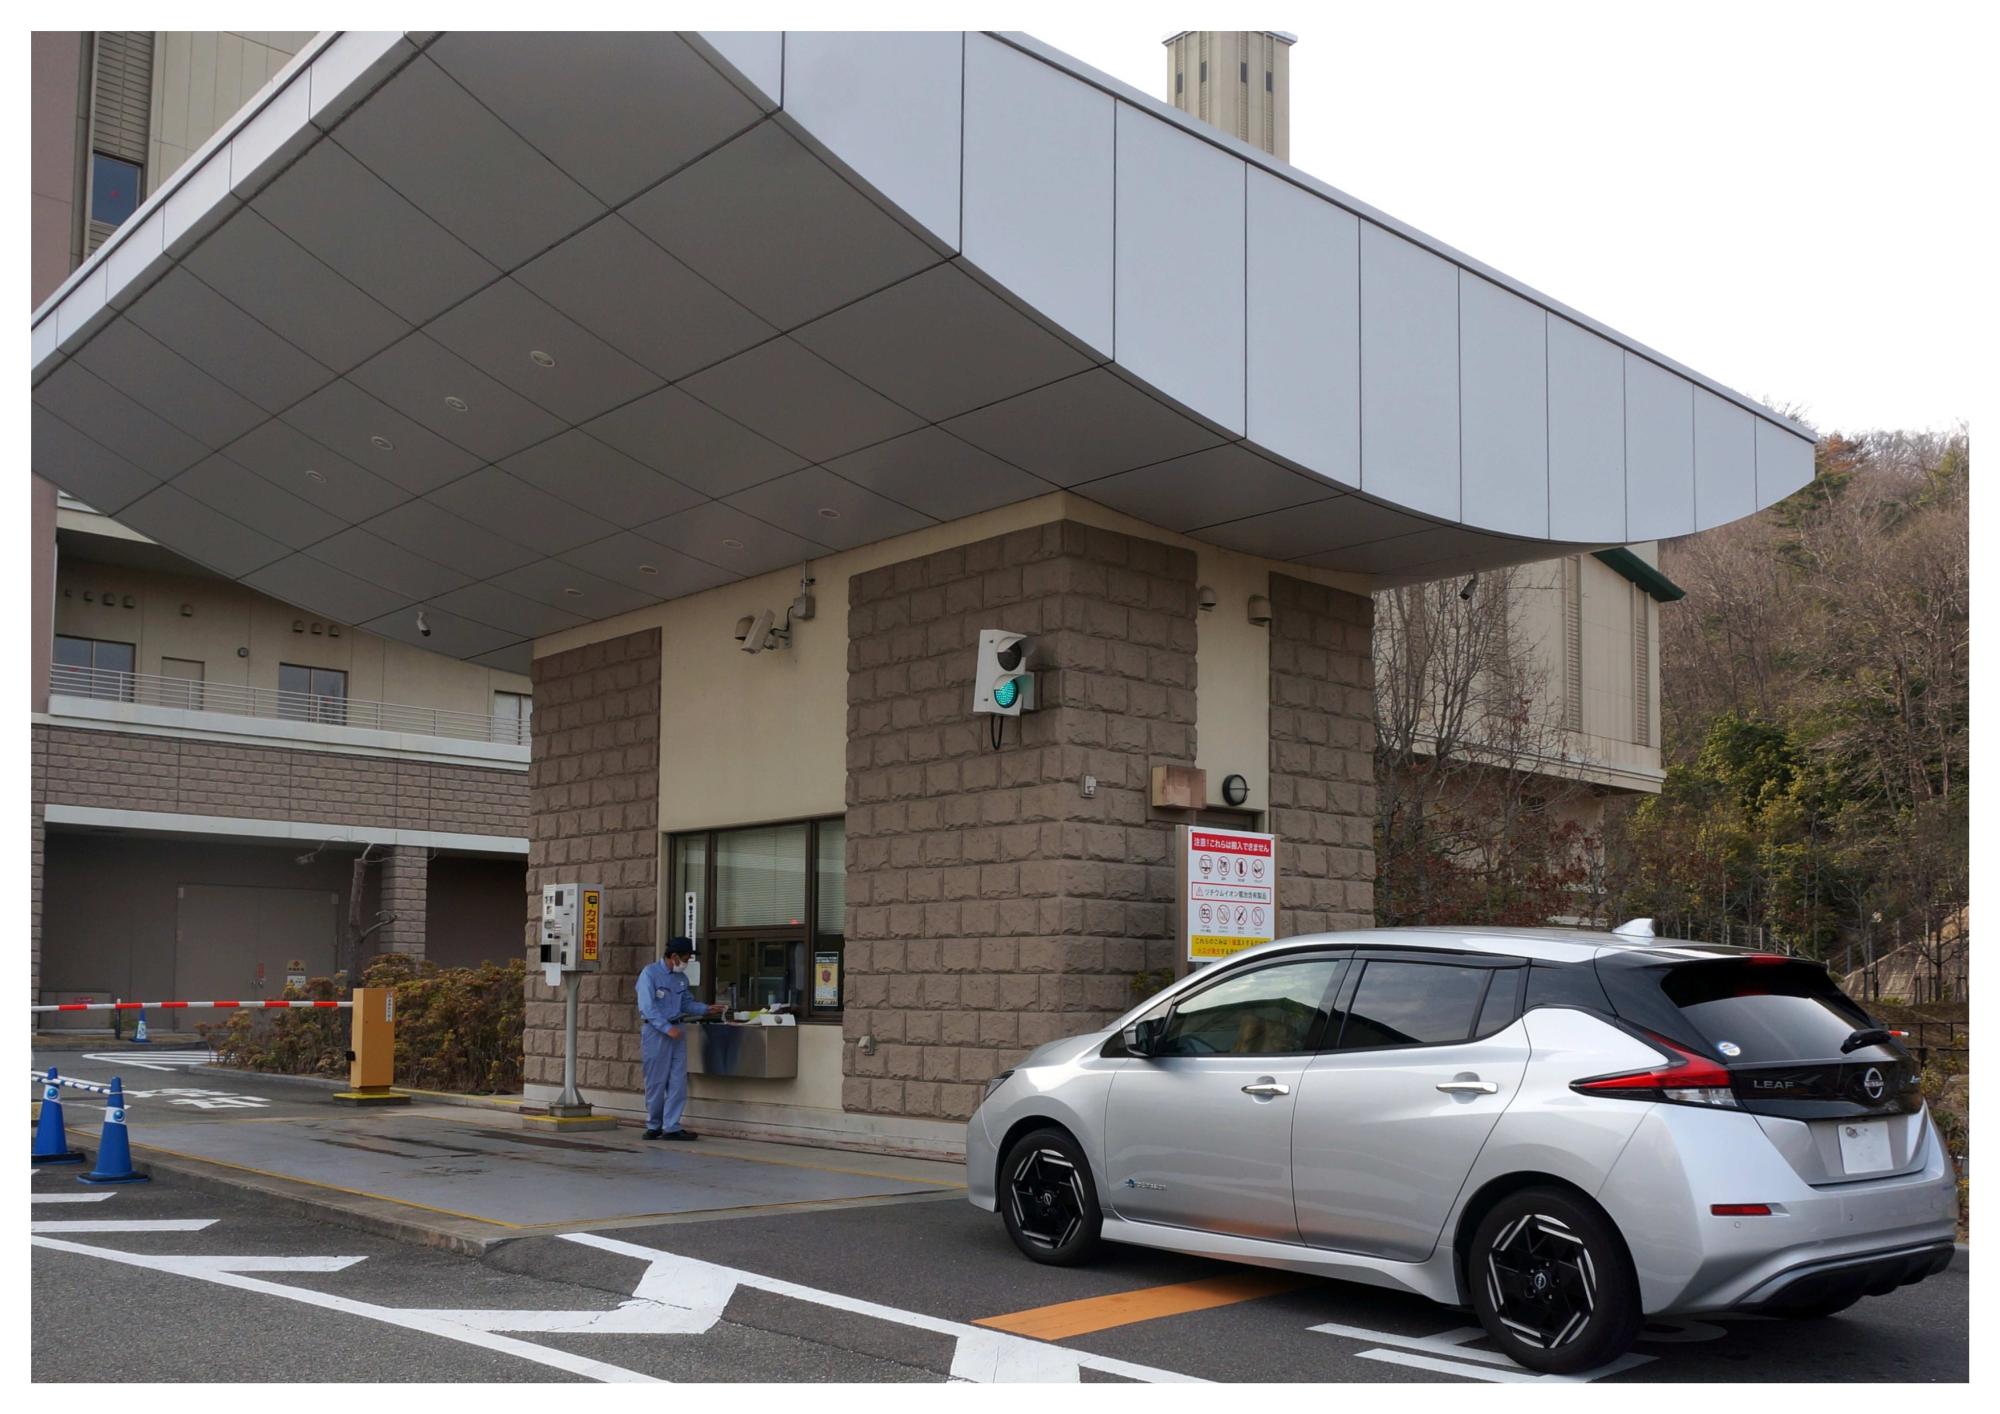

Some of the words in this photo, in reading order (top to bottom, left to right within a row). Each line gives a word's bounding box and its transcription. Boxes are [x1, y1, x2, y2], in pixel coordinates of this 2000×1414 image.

[585, 909, 597, 955] カメラ作動中
[1753, 1080, 1794, 1089] LEAF
